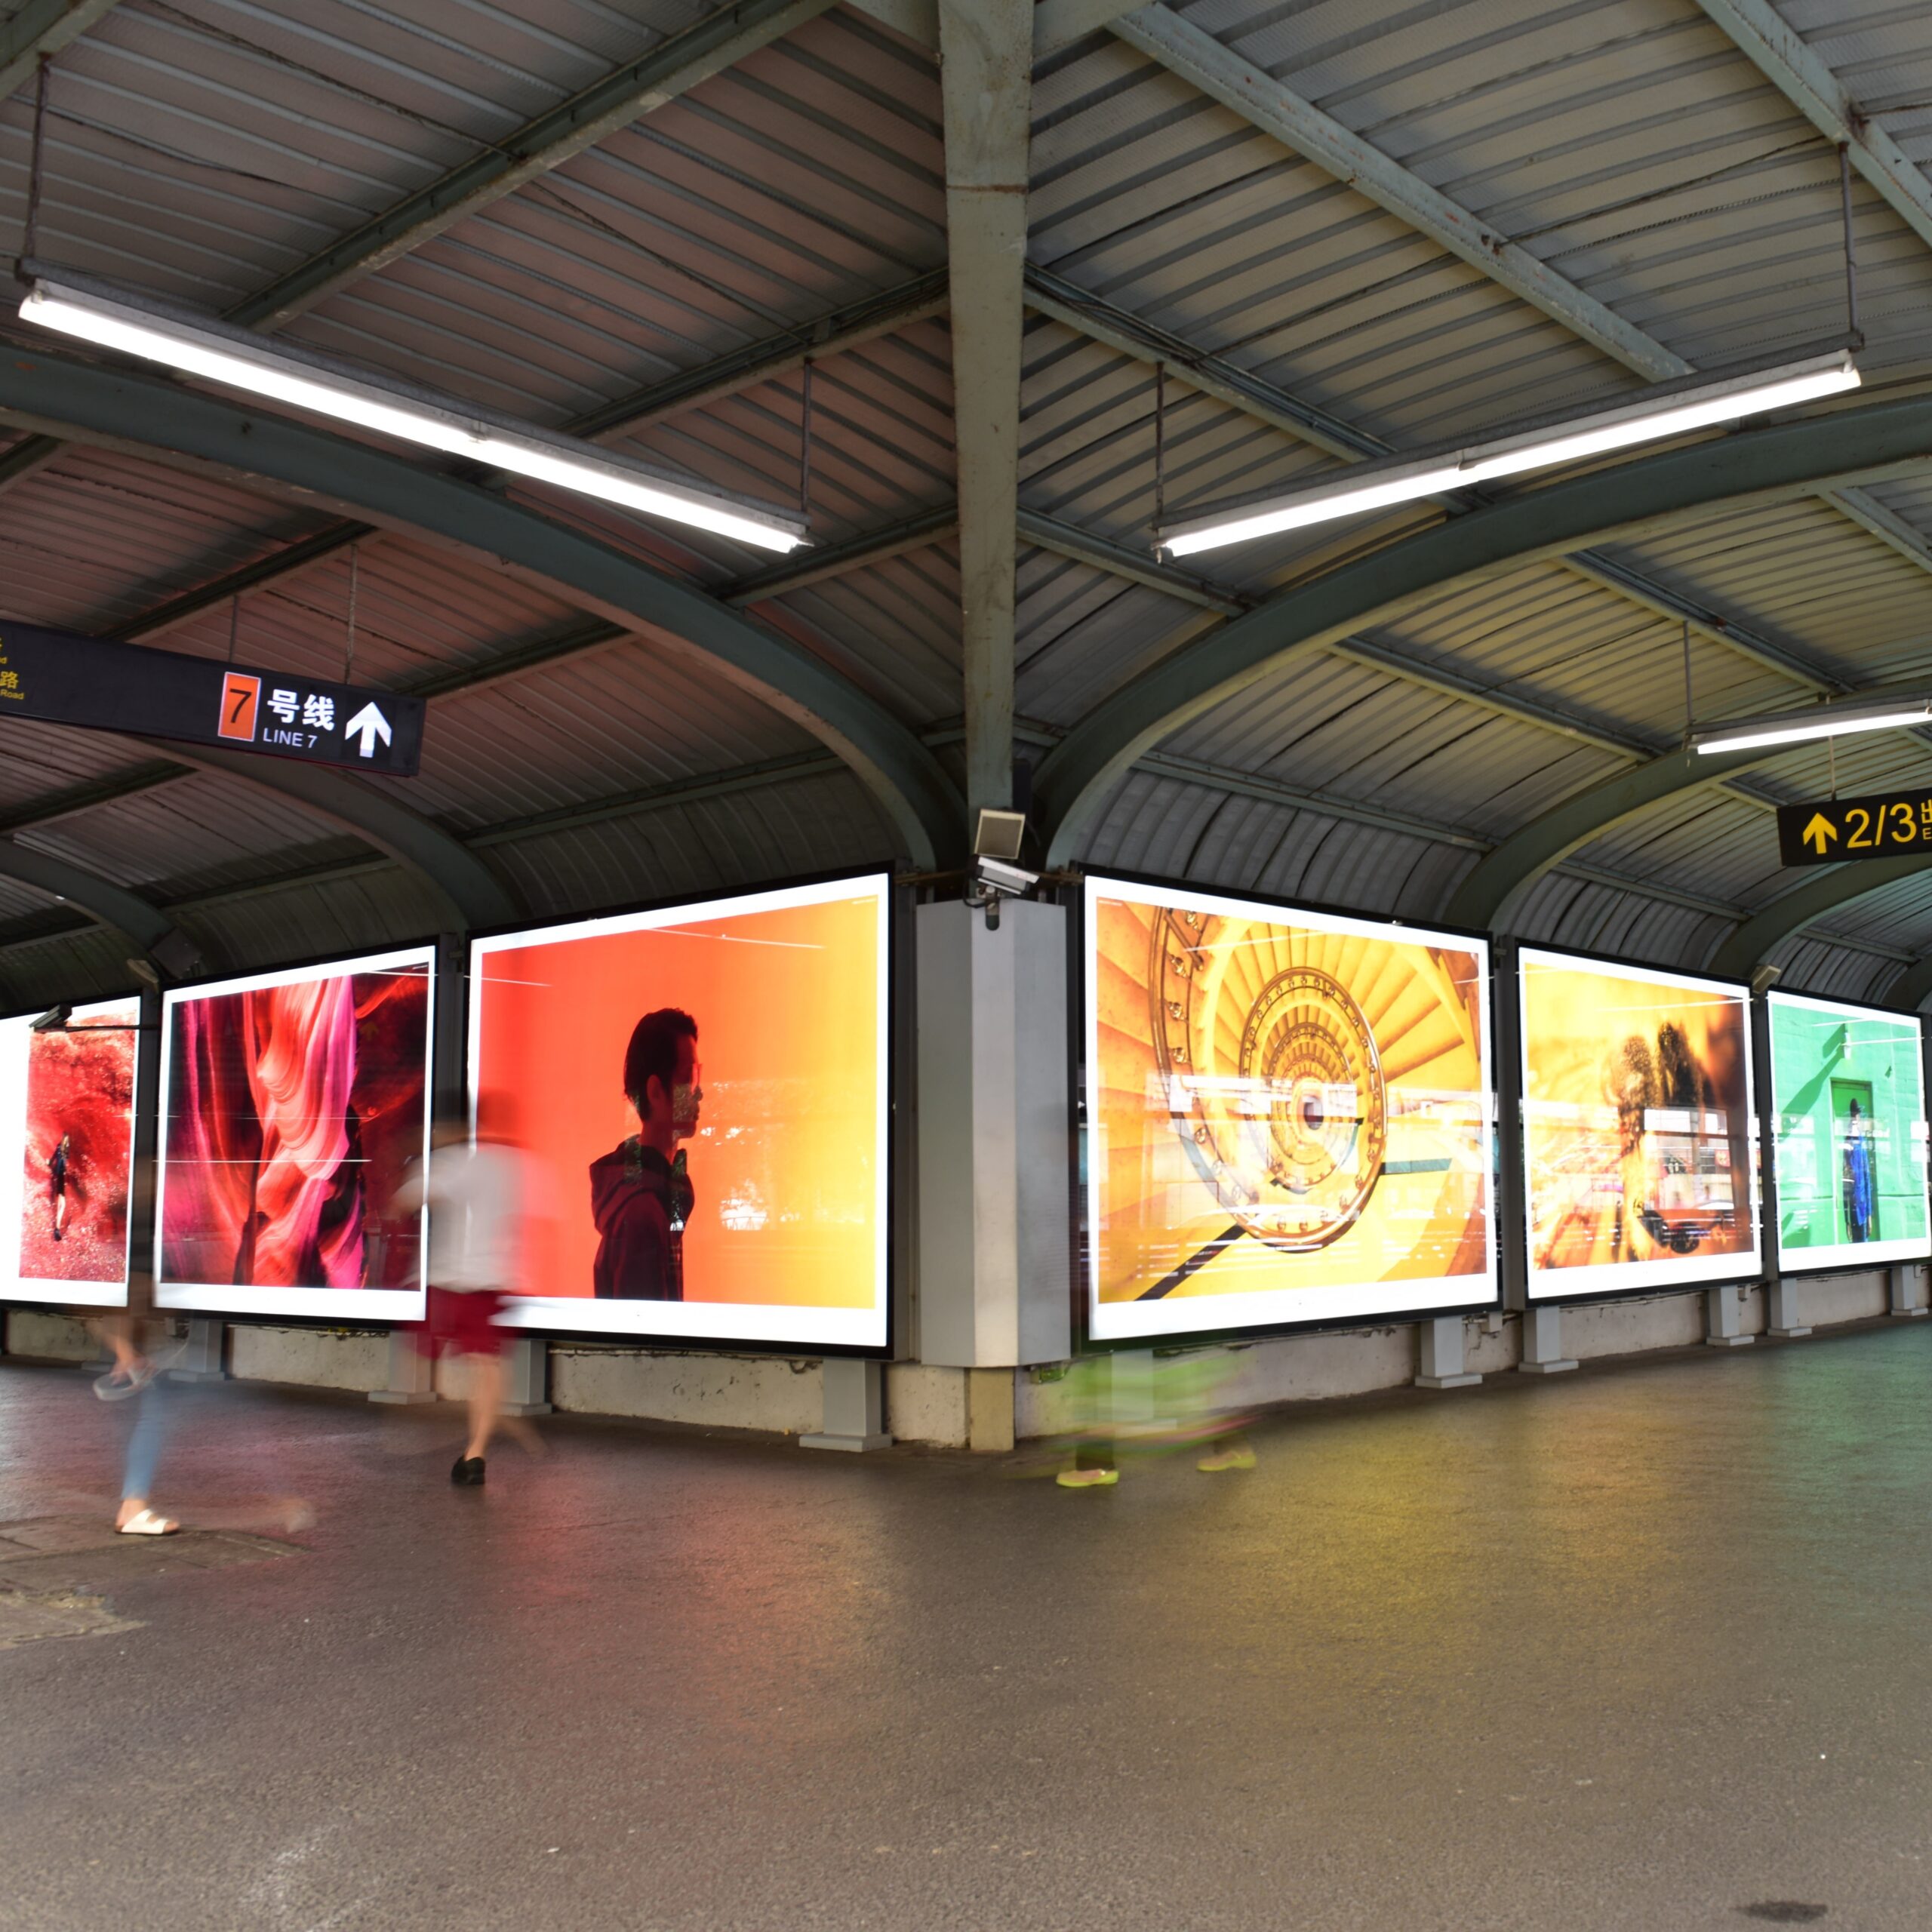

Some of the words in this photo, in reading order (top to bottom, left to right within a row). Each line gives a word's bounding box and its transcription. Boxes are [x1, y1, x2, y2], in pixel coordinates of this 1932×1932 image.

[0, 688, 24, 700] Road
[266, 688, 336, 731] 号线
[263, 728, 304, 747] LINE
[307, 734, 318, 749] 7
[1844, 802, 1917, 848] 2/3
